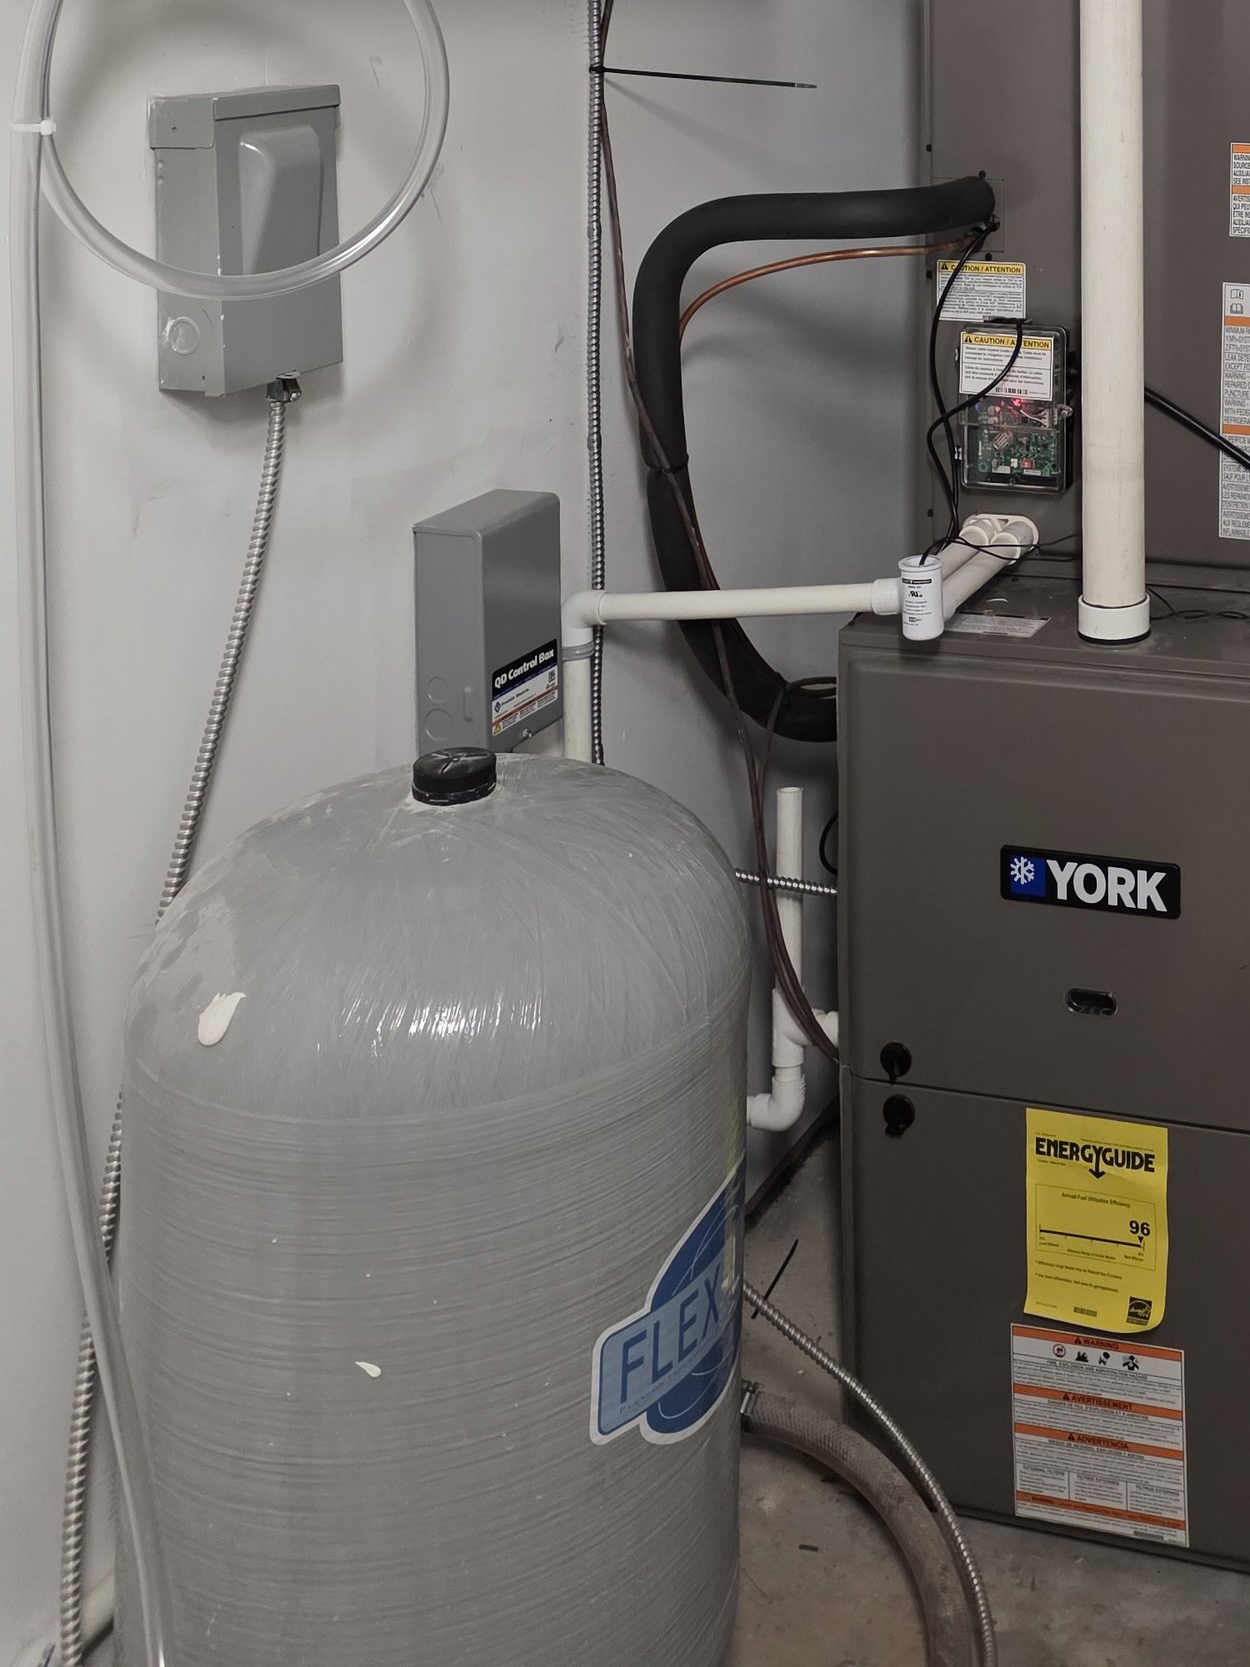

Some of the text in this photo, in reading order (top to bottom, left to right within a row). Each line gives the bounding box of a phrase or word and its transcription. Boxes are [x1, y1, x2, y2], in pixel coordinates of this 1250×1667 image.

[951, 264, 979, 272] CUTION
[974, 336, 1005, 345] CAUTION
[1010, 338, 1049, 348] AENTION
[1225, 362, 1243, 370] EXCEPT
[1225, 372, 1246, 380] WARNING
[494, 648, 554, 689] QD Control Box
[1046, 859, 1168, 912] YORK
[1035, 1136, 1155, 1176] ENERGYGUIDE
[1129, 1220, 1151, 1237] 96
[1082, 1337, 1119, 1350] WARNING
[1071, 1394, 1133, 1411] AVERTISSEMENT
[1076, 1435, 1129, 1450] ADVERTENCIA
